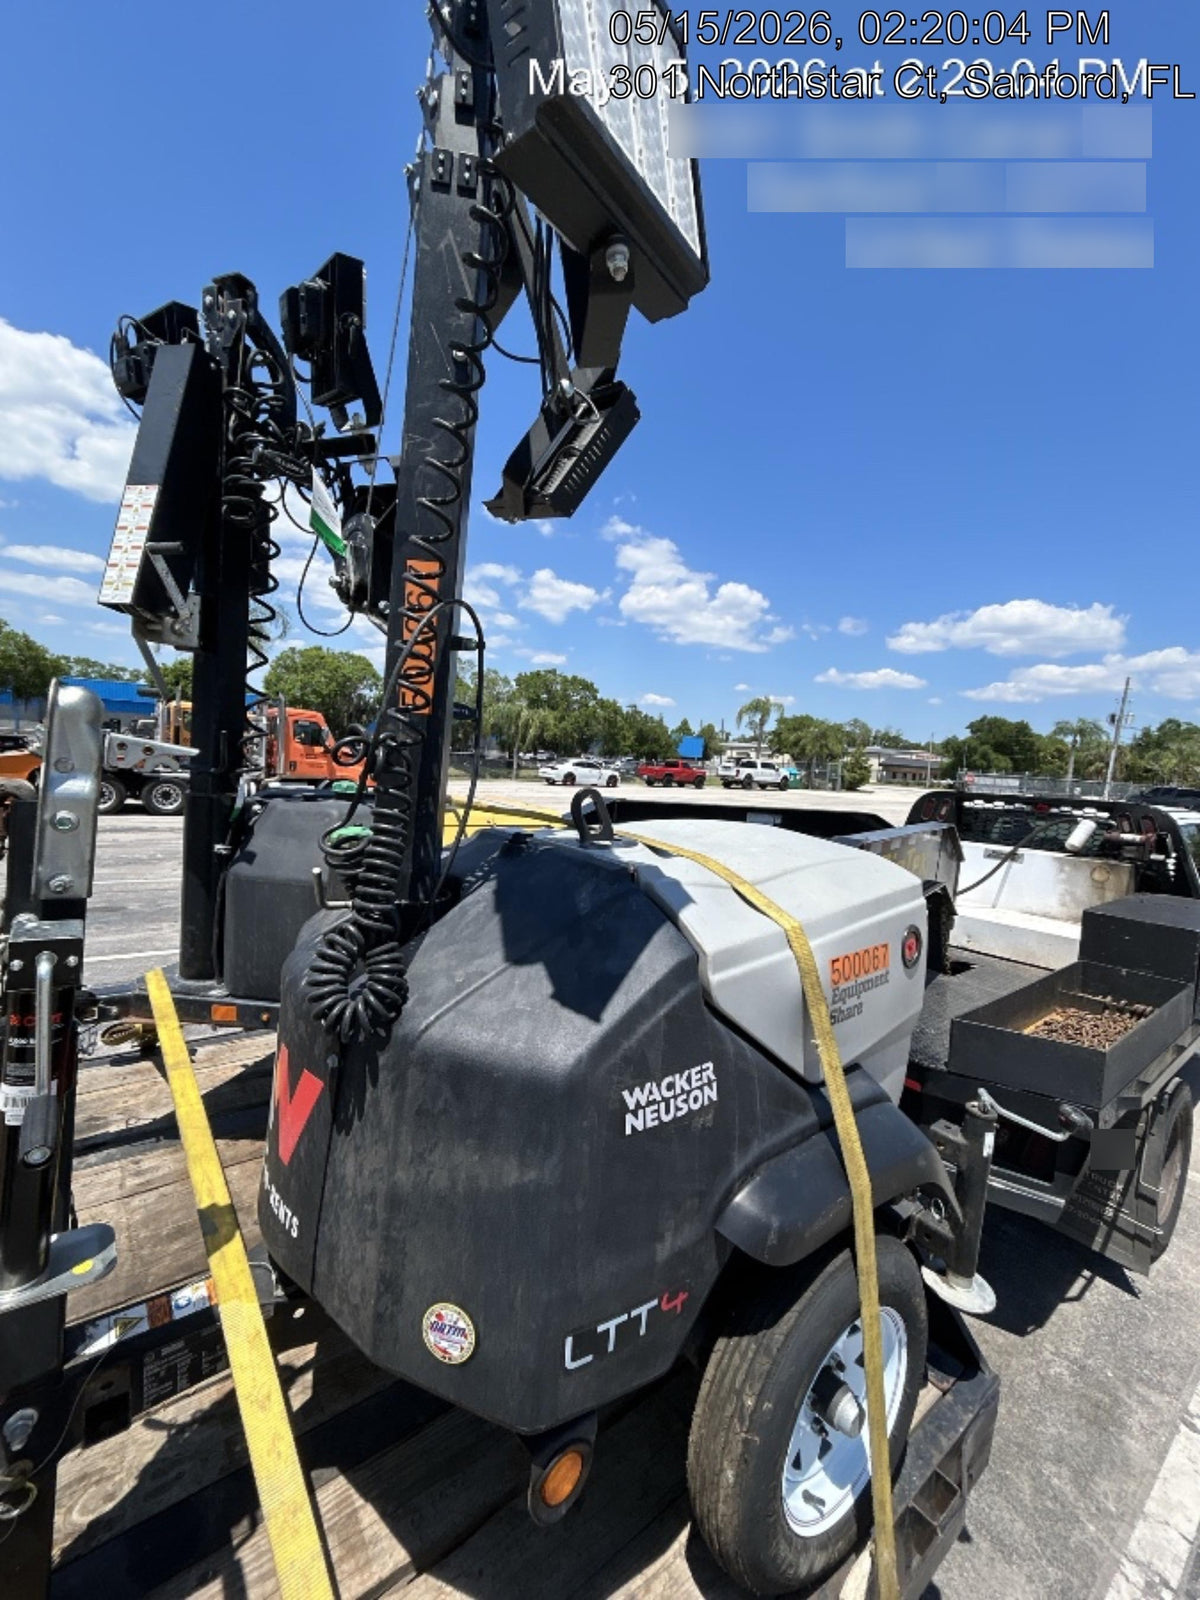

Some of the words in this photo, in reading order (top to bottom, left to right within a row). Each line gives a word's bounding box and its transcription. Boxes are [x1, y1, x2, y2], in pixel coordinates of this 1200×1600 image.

[831, 943, 889, 986] 500067
[831, 969, 890, 1006] Equipment
[829, 1002, 864, 1026] Share
[621, 1061, 717, 1111] WACKER
[624, 1081, 719, 1135] NEUSON
